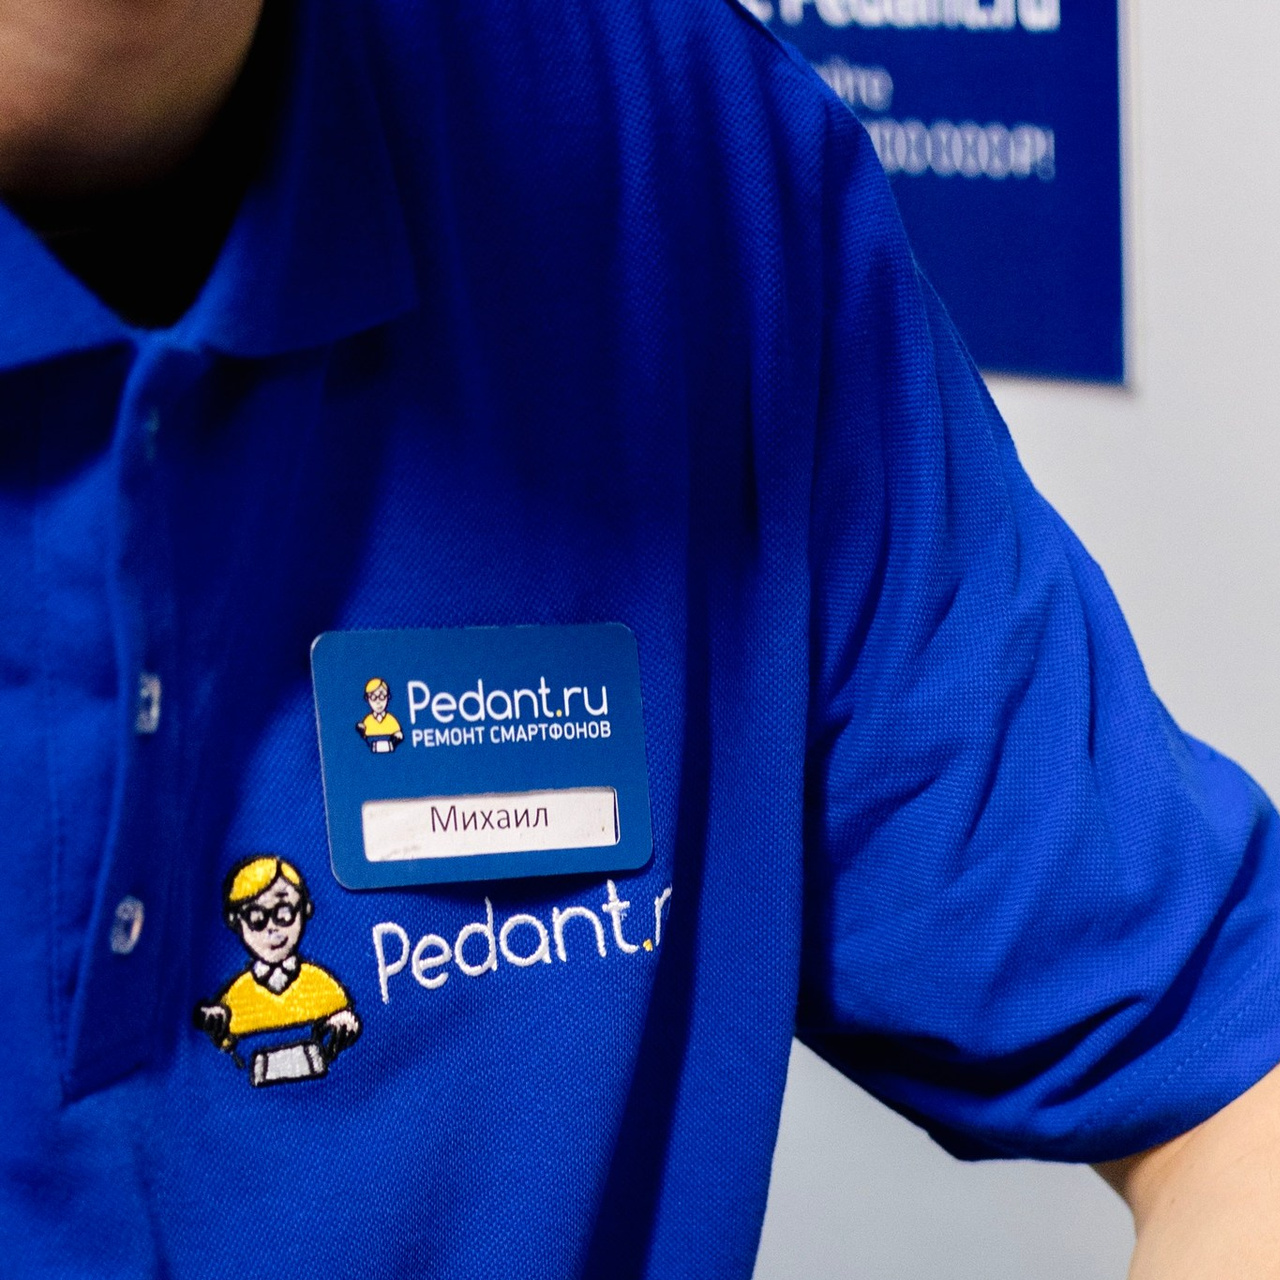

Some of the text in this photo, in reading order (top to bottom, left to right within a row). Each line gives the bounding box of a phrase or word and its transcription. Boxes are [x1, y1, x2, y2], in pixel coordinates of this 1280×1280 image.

[407, 676, 609, 726] Pedant.ru
[412, 720, 612, 749] РЕМОНТ СМАРТФОНОВ
[430, 805, 550, 834] Михаил
